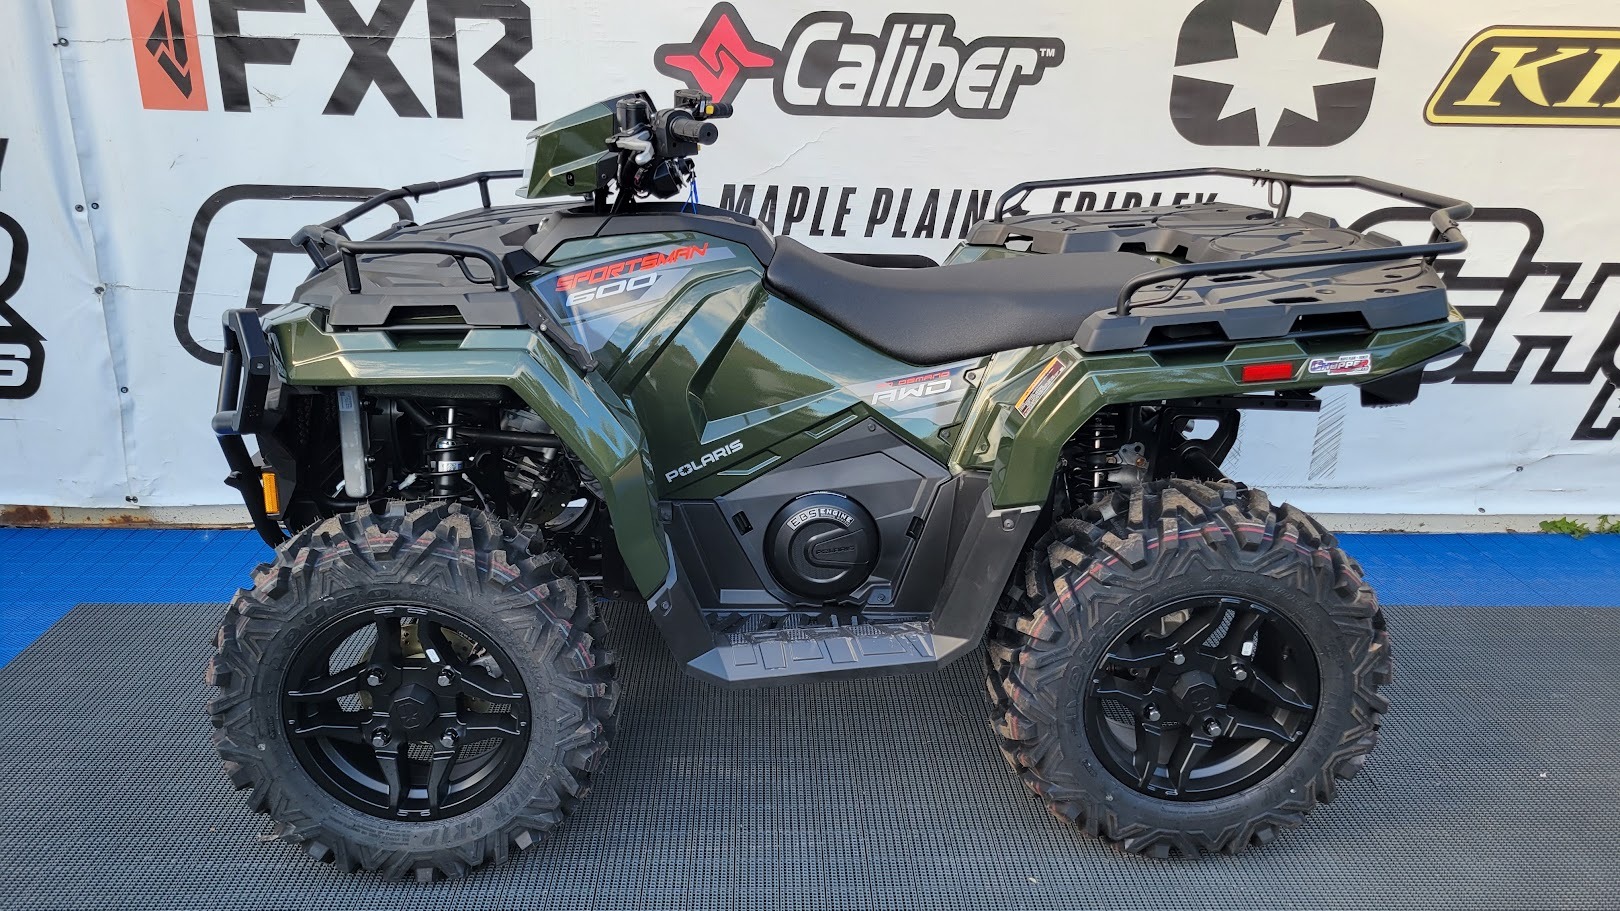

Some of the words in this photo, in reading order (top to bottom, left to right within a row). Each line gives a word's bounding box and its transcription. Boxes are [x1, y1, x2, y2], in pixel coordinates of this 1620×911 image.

[210, 0, 537, 121] FXR
[783, 22, 1038, 110] Caliber
[719, 184, 857, 237] MAPLE
[864, 187, 993, 239] PLAIN
[555, 242, 709, 292] SPORTSMAN
[566, 272, 658, 307] 600
[871, 379, 952, 405] AWD
[898, 370, 951, 386] DEMAND
[665, 439, 744, 483] POLARIS
[820, 508, 854, 523] ENGINE
